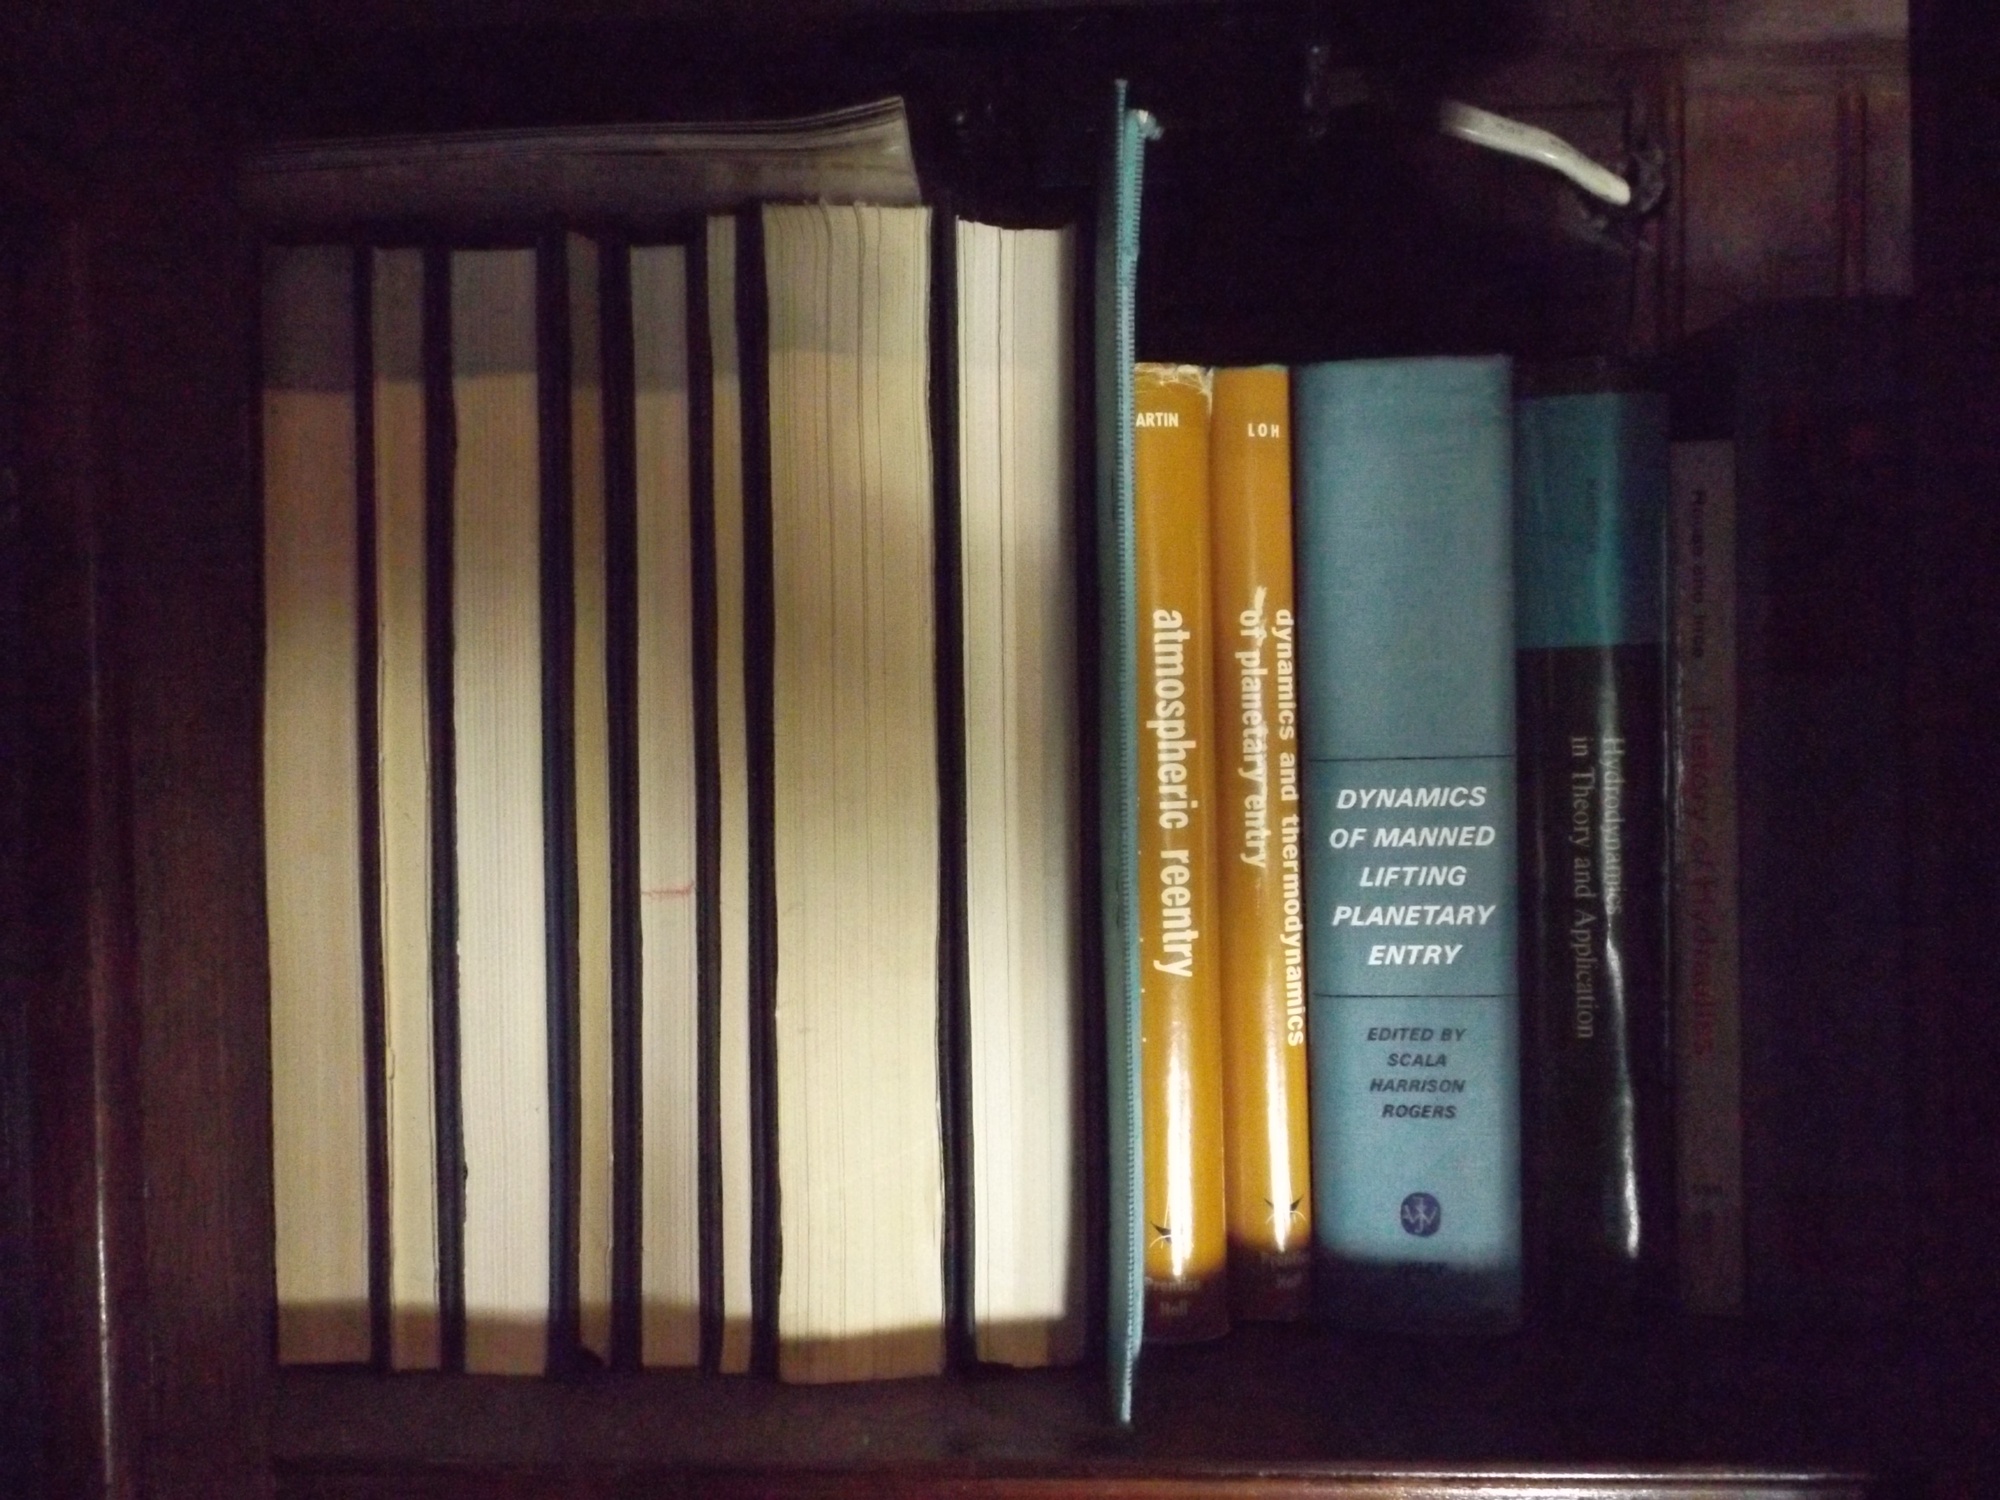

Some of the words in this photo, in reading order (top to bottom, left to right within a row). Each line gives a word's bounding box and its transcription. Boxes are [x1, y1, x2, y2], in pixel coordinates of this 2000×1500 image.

[1248, 422, 1280, 438] LOH
[1239, 610, 1266, 642] of
[1271, 609, 1297, 741] dynamics
[1146, 609, 1199, 830] atmospheric
[1234, 650, 1268, 788] planetary
[1571, 737, 1594, 757] in
[1280, 752, 1300, 802] and
[1336, 786, 1487, 809] DYNAMICS
[1568, 766, 1596, 848] Theory
[1240, 794, 1272, 869] entry
[1329, 828, 1367, 848] OF
[1373, 826, 1495, 847] MANNED
[1600, 737, 1625, 915] Hydrodynamics
[1359, 865, 1467, 887] LIFTING
[1574, 857, 1598, 899] and
[1153, 849, 1199, 978] reentry
[1332, 904, 1496, 926] PLANETARY
[1279, 813, 1306, 1047] thermodynamics
[1367, 944, 1463, 966] ENTRY
[1569, 908, 1599, 1040] Application
[1367, 1027, 1434, 1042] EDITED
[1441, 1028, 1467, 1042] BY
[1387, 1053, 1447, 1067] SCALA
[1369, 1078, 1466, 1093] HARRISON
[1382, 1104, 1457, 1118] ROGERS
